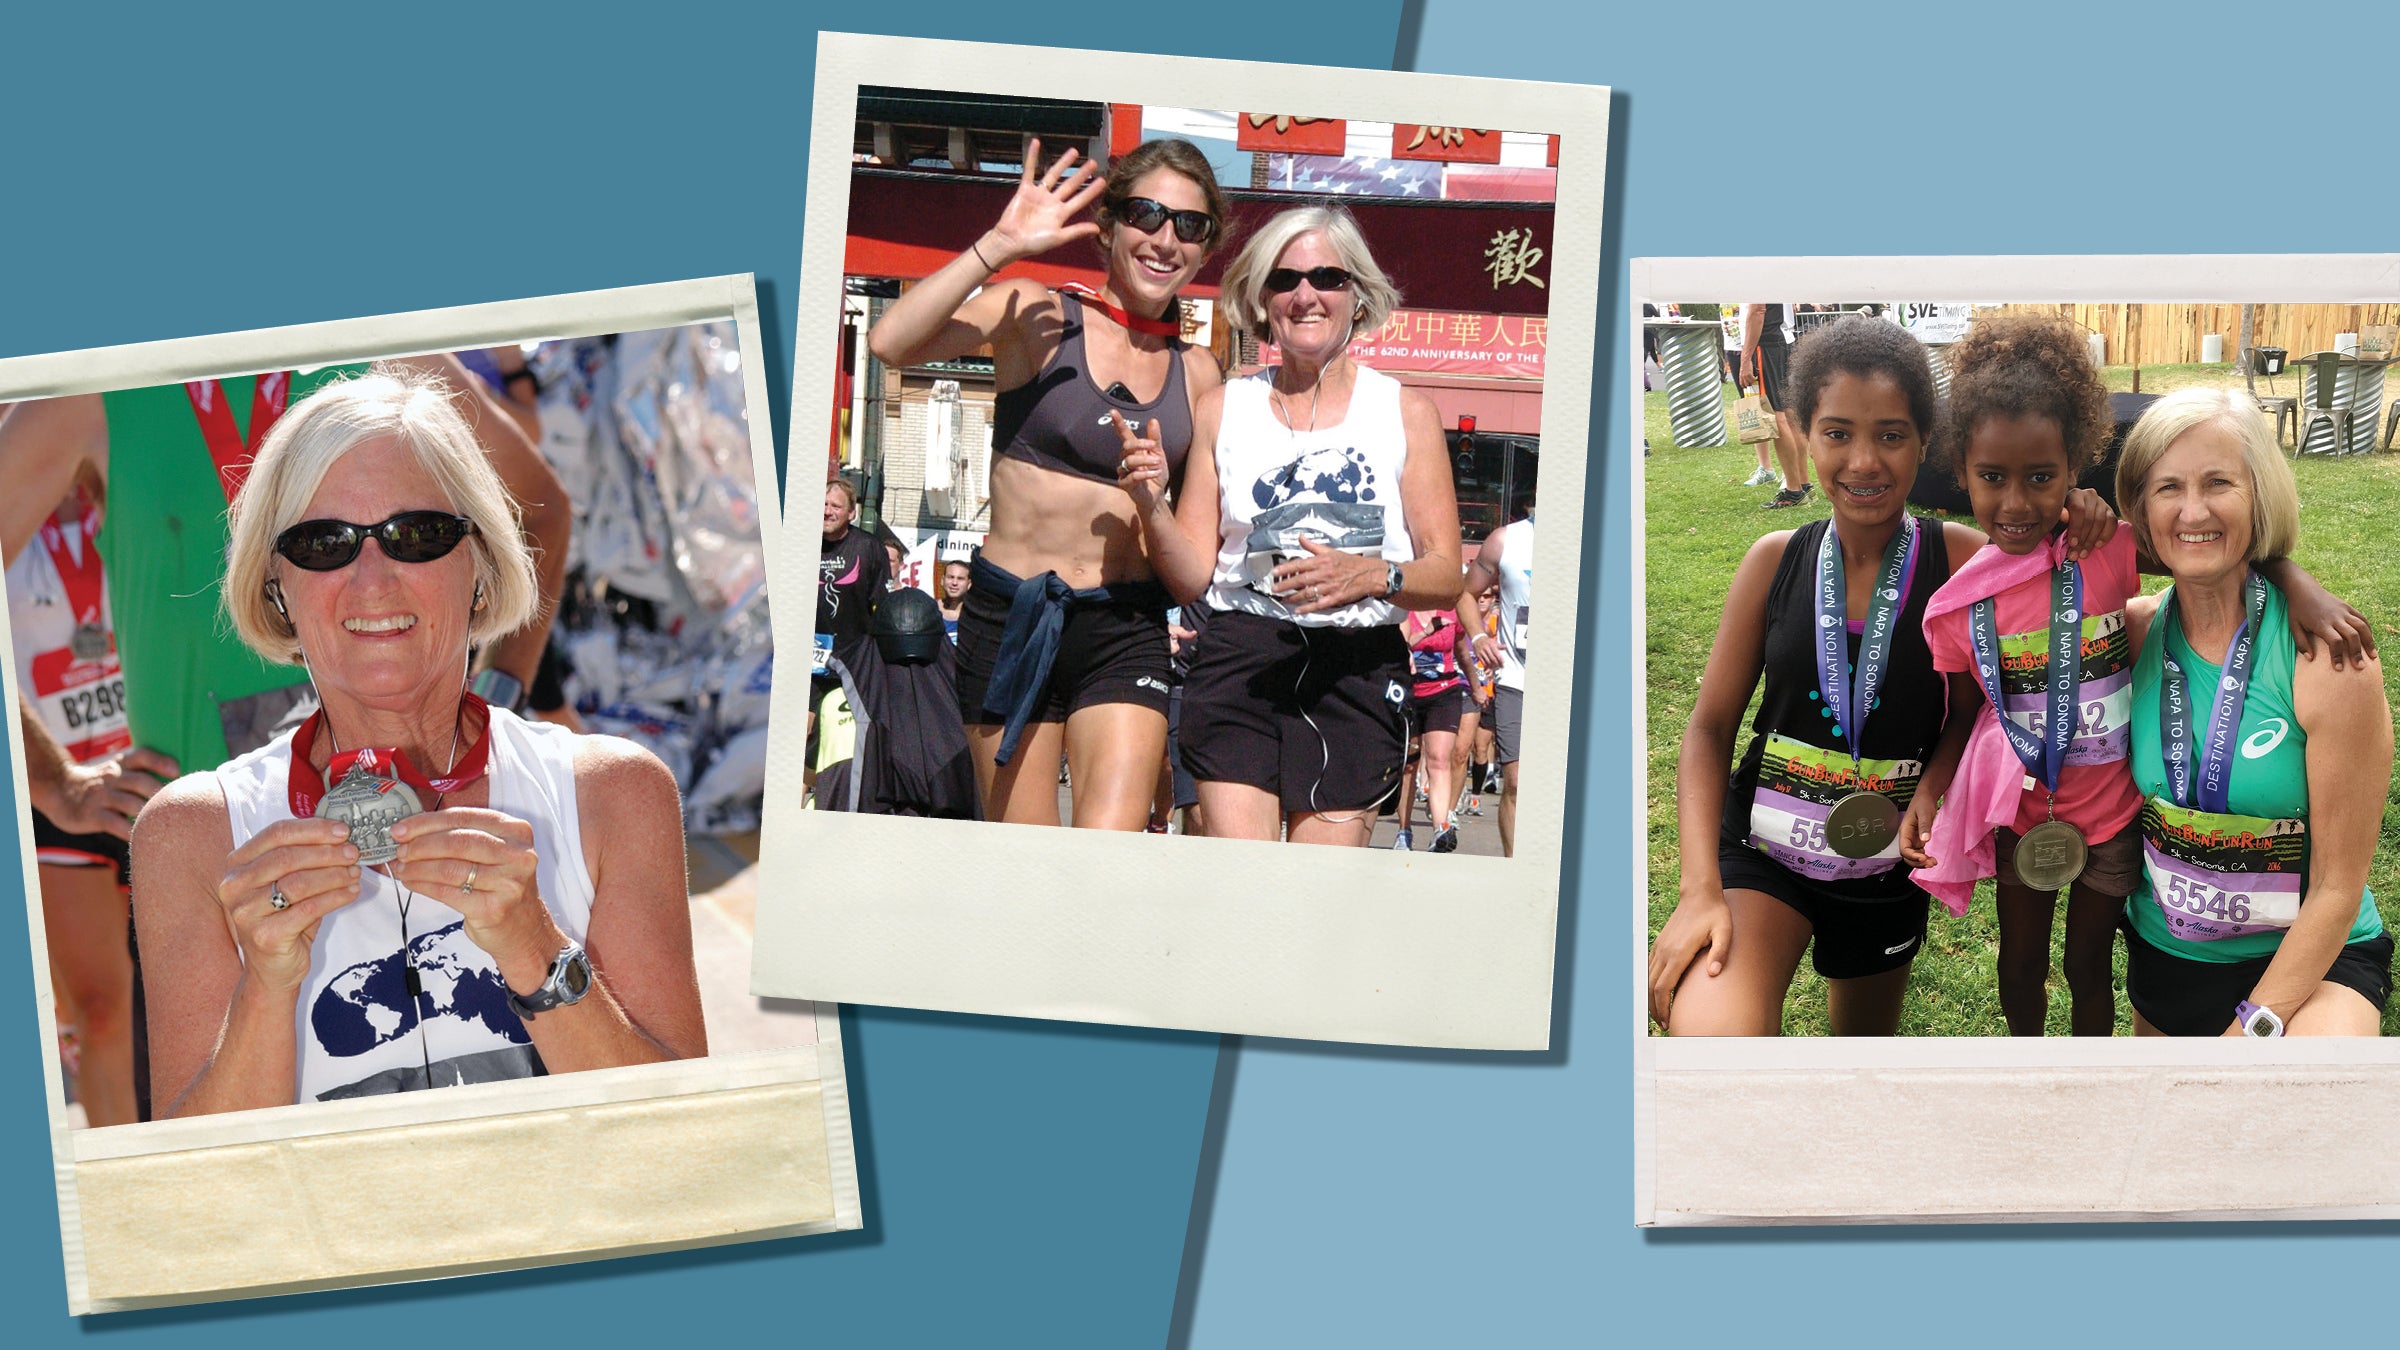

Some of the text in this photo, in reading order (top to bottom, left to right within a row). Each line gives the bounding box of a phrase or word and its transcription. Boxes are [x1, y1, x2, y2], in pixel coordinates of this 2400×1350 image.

[1354, 346, 1540, 364] THE 62ND ANNIVERSARY OF THE
[1823, 561, 1834, 576] TO
[1824, 578, 1836, 608] NAPA
[1872, 606, 1890, 639] NAPA
[1975, 602, 1990, 656] NAPA TO
[1868, 643, 1882, 660] TO
[2060, 632, 2072, 668] NAPA
[2058, 671, 2070, 690] TO
[2056, 694, 2069, 751] SONOMA
[2206, 635, 2251, 792] DESTINATION NAPA
[2169, 680, 2184, 800] NAPA TO SONOMA
[1789, 817, 1828, 853] 55
[1807, 859, 1837, 871] Alaska
[2191, 855, 2228, 872] Sonoma,
[2231, 862, 2248, 872] CA
[2166, 874, 2251, 924] 5546
[2186, 921, 2219, 935] Alaska
